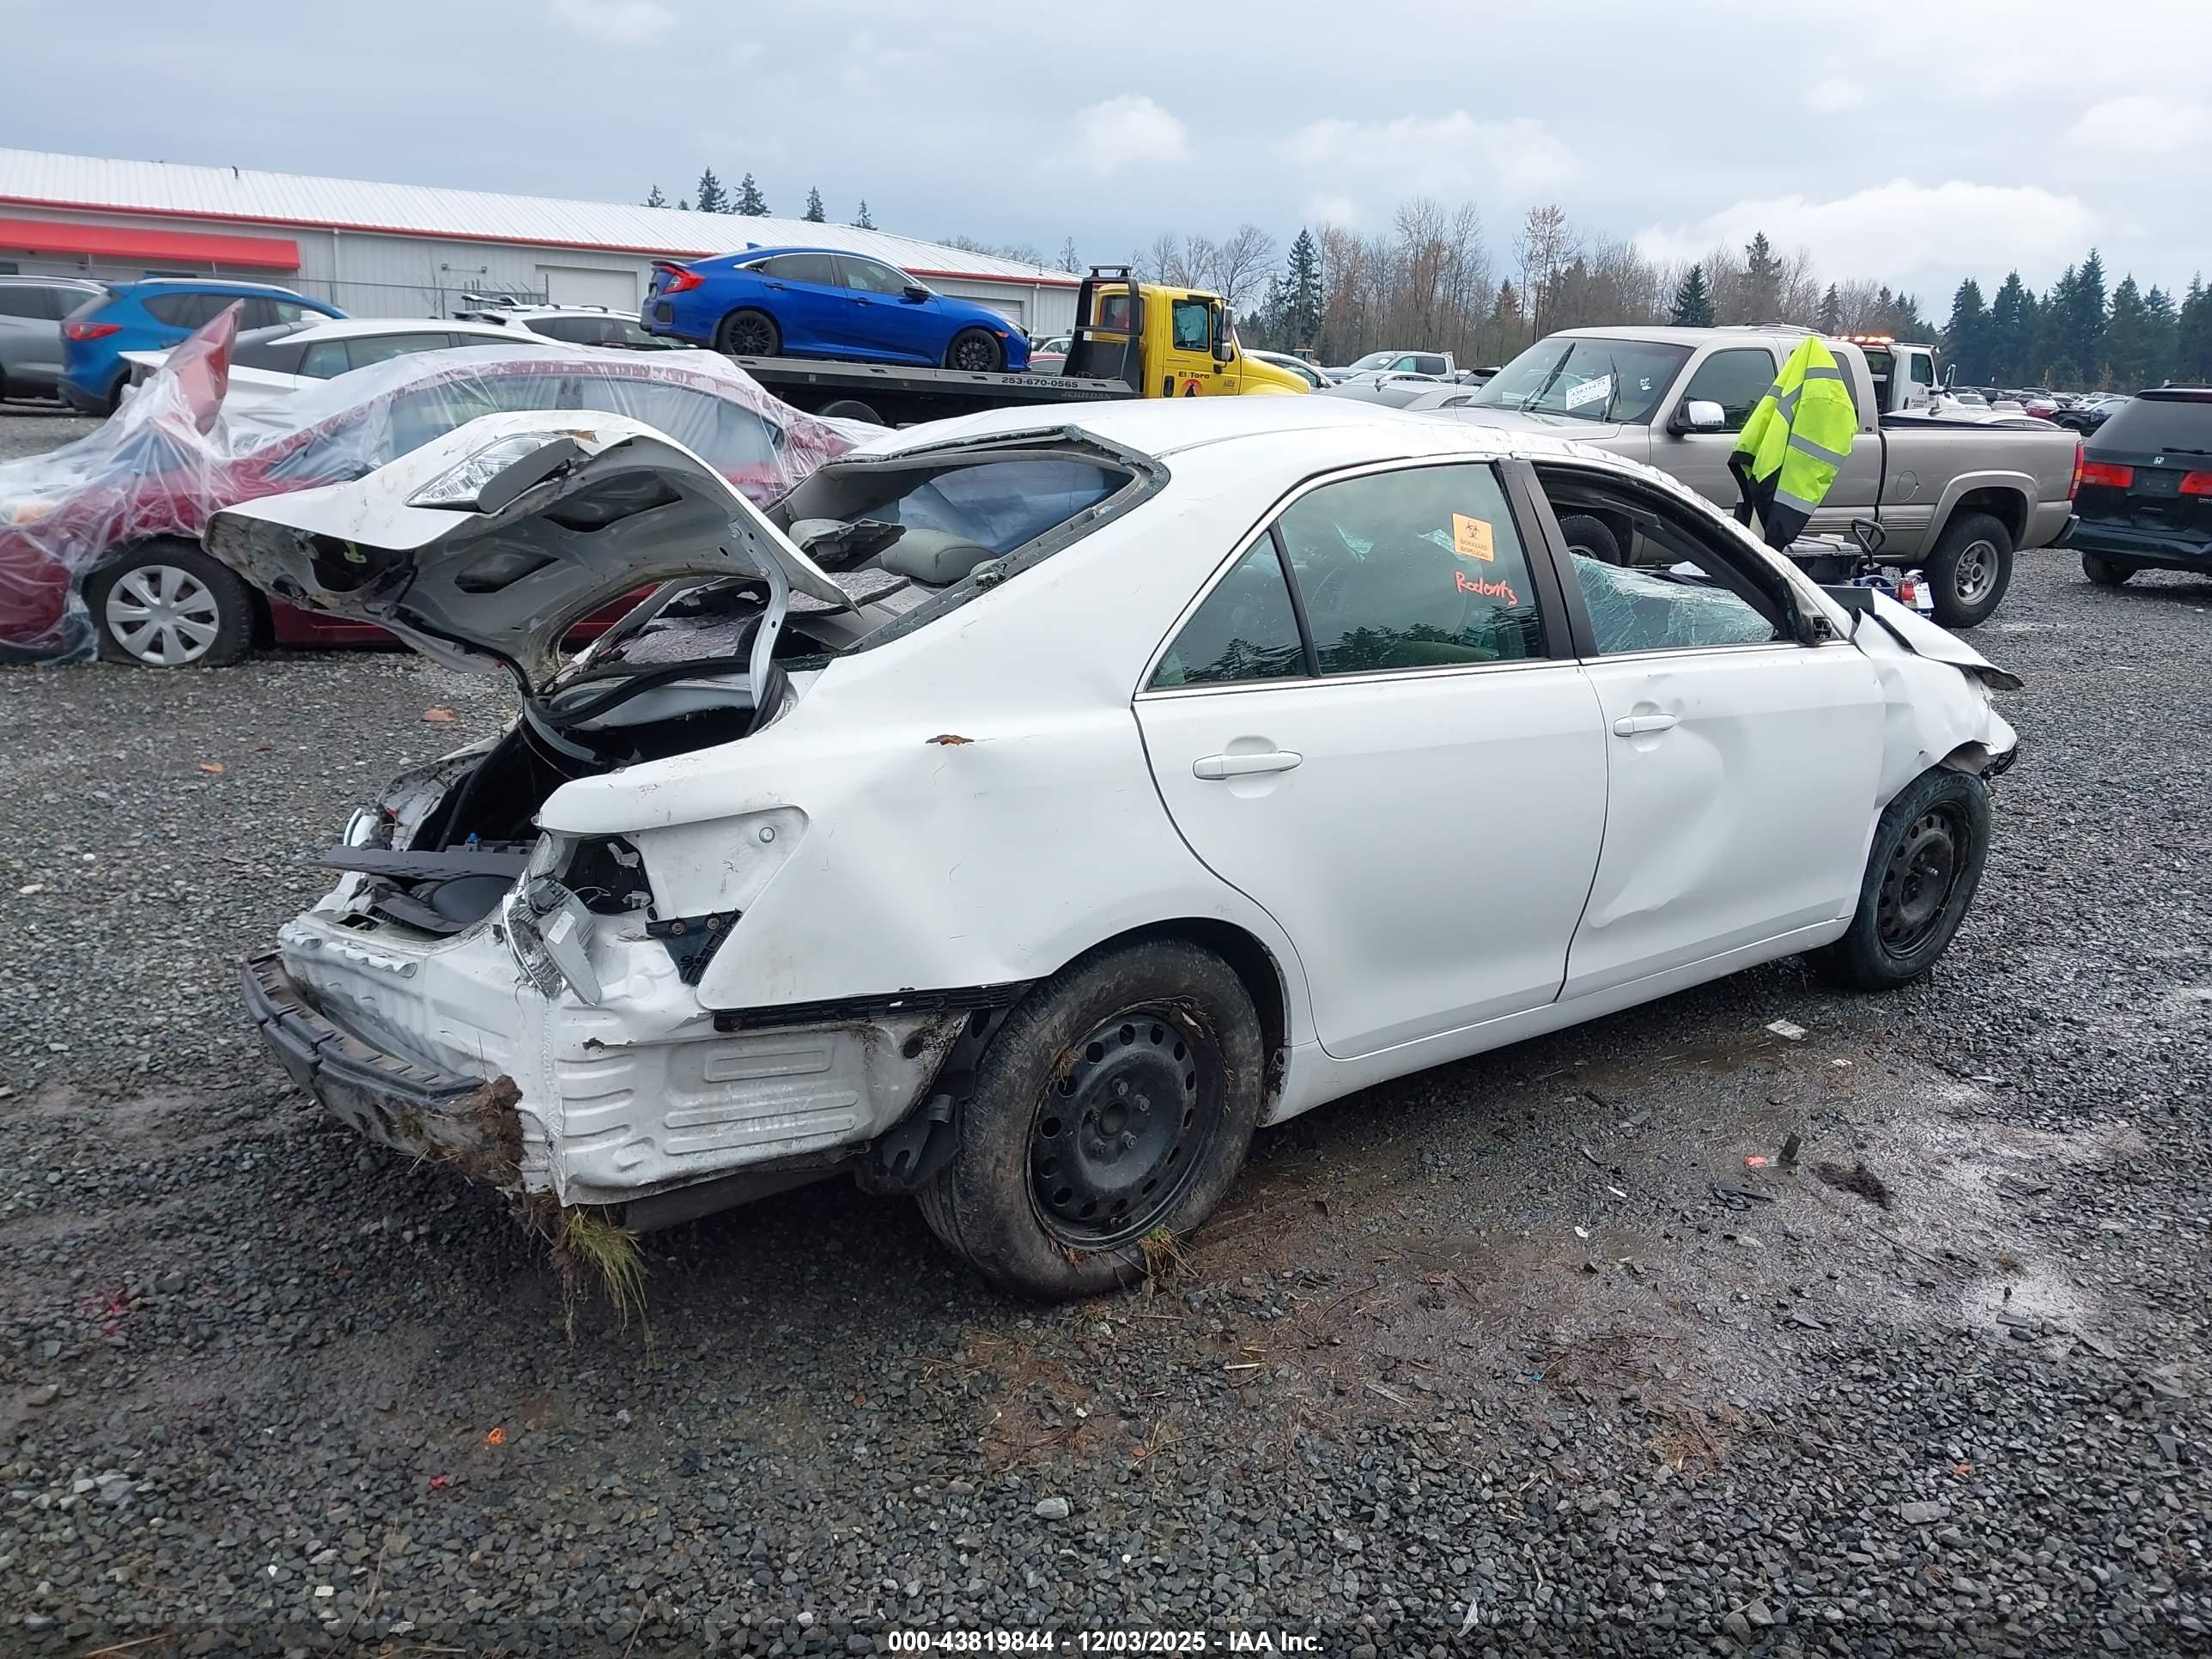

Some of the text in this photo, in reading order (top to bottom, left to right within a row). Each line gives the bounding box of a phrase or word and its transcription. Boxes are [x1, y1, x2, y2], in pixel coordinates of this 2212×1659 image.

[1000, 376, 1079, 388] 253-670-0565
[1460, 538, 1488, 551] BIOHAZARD
[1455, 570, 1518, 606] Rodents
